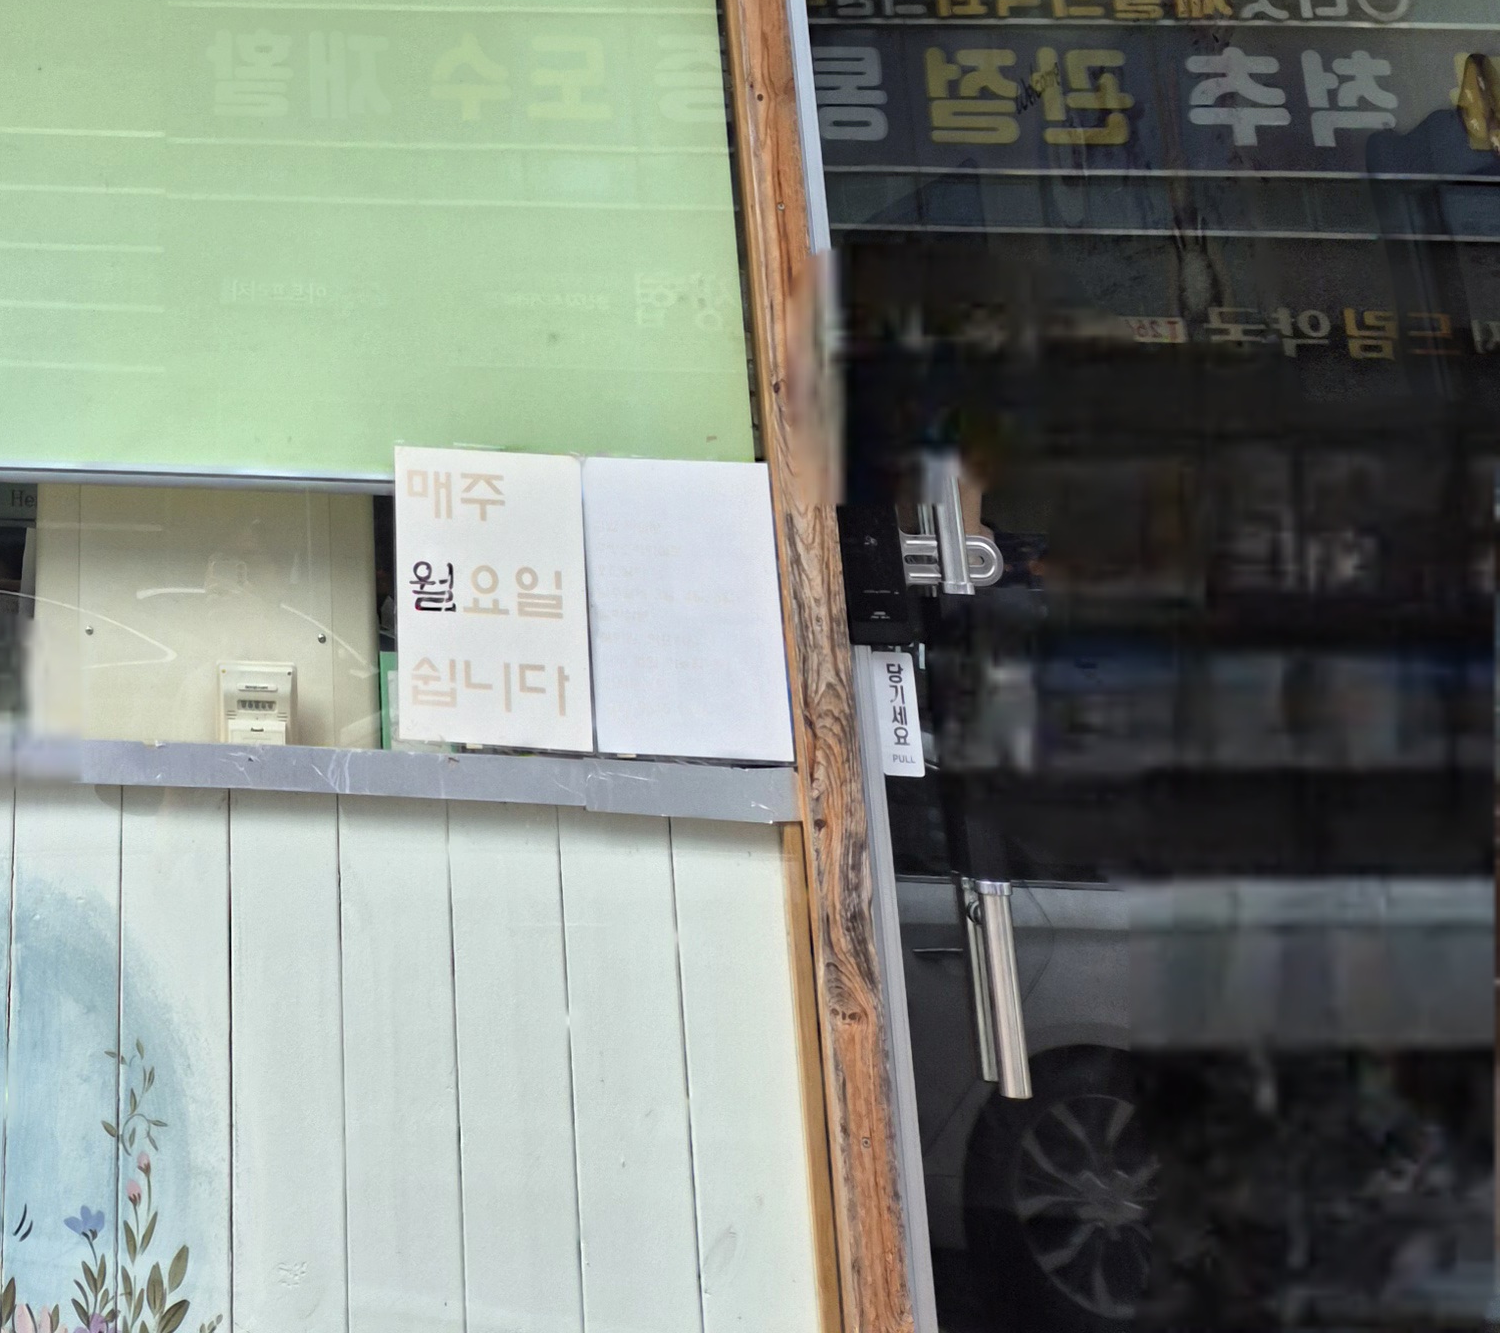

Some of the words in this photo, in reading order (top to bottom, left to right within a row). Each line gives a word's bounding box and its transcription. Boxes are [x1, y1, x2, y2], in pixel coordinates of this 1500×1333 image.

[406, 467, 506, 522] 매주
[408, 560, 565, 621] 월요일
[410, 654, 571, 717] 쉽니다
[886, 663, 911, 746] 당기세요
[892, 753, 917, 765] PULL
